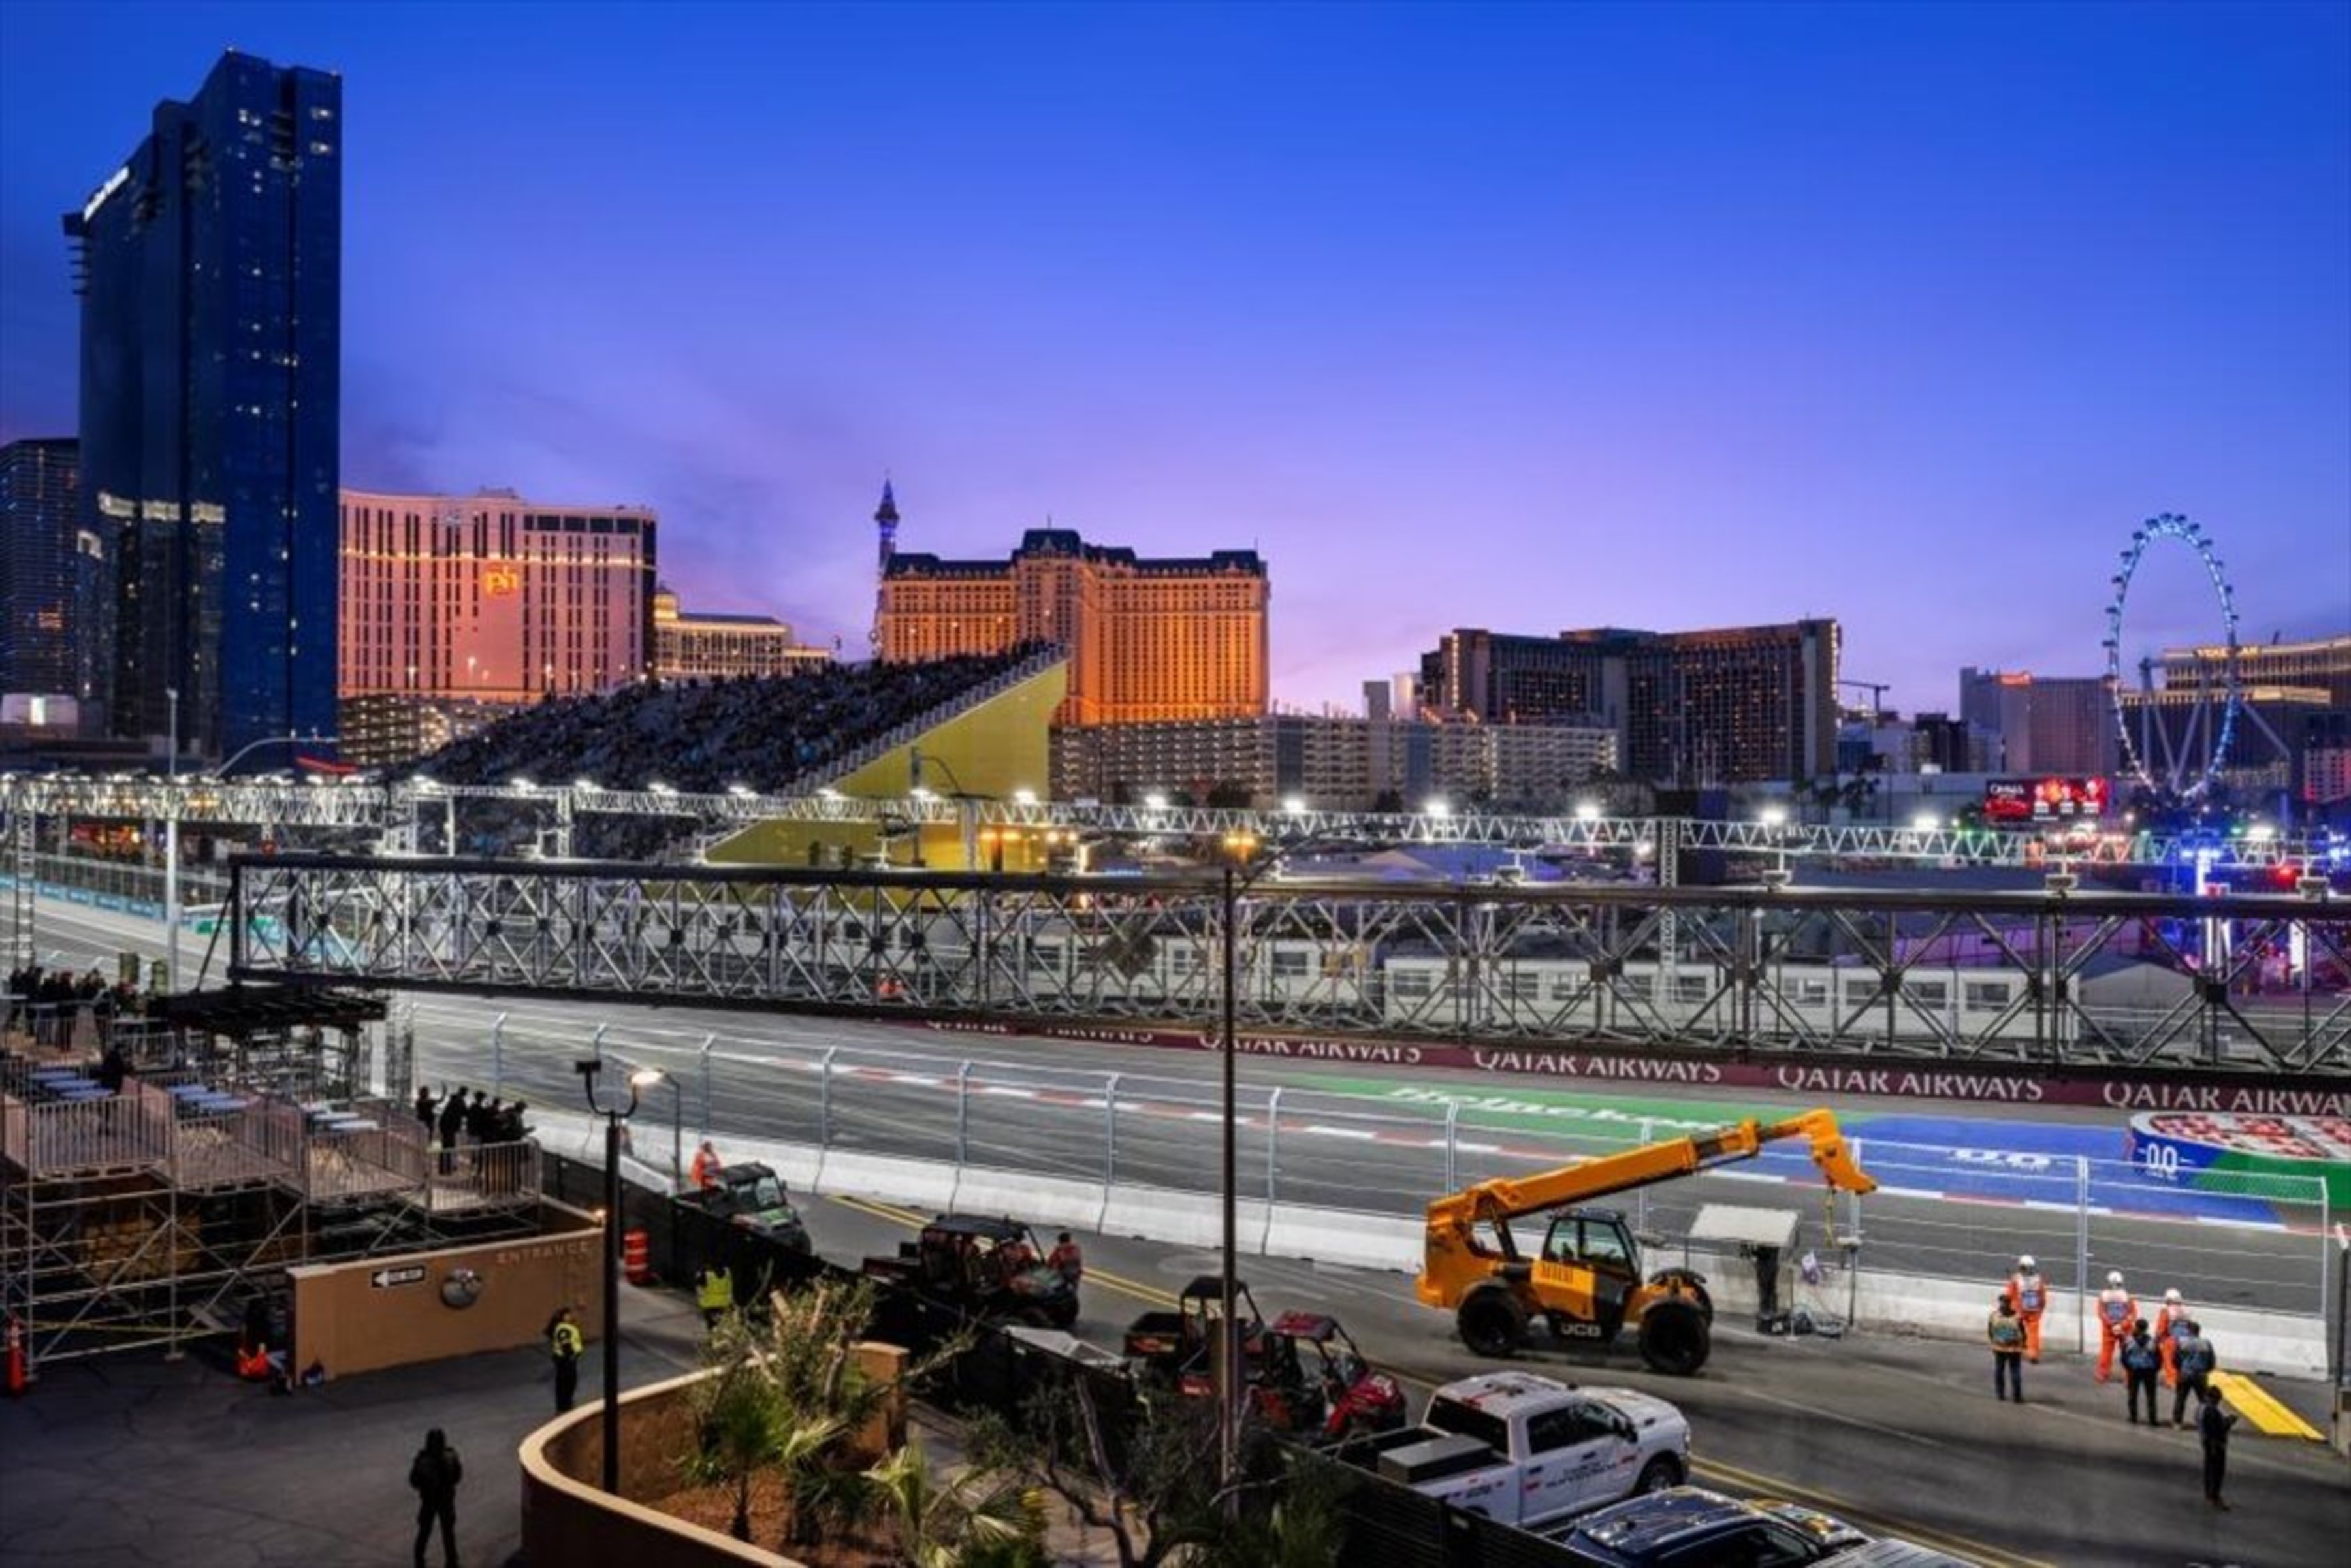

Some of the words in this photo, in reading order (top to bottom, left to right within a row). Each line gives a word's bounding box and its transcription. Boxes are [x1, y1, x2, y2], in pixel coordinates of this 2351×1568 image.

[1586, 1056, 1721, 1082] AIRWAYS
[1778, 1066, 1889, 1093] QATAR
[1898, 1072, 2043, 1100] AIRWAYS
[2103, 1081, 2220, 1107] QATAR
